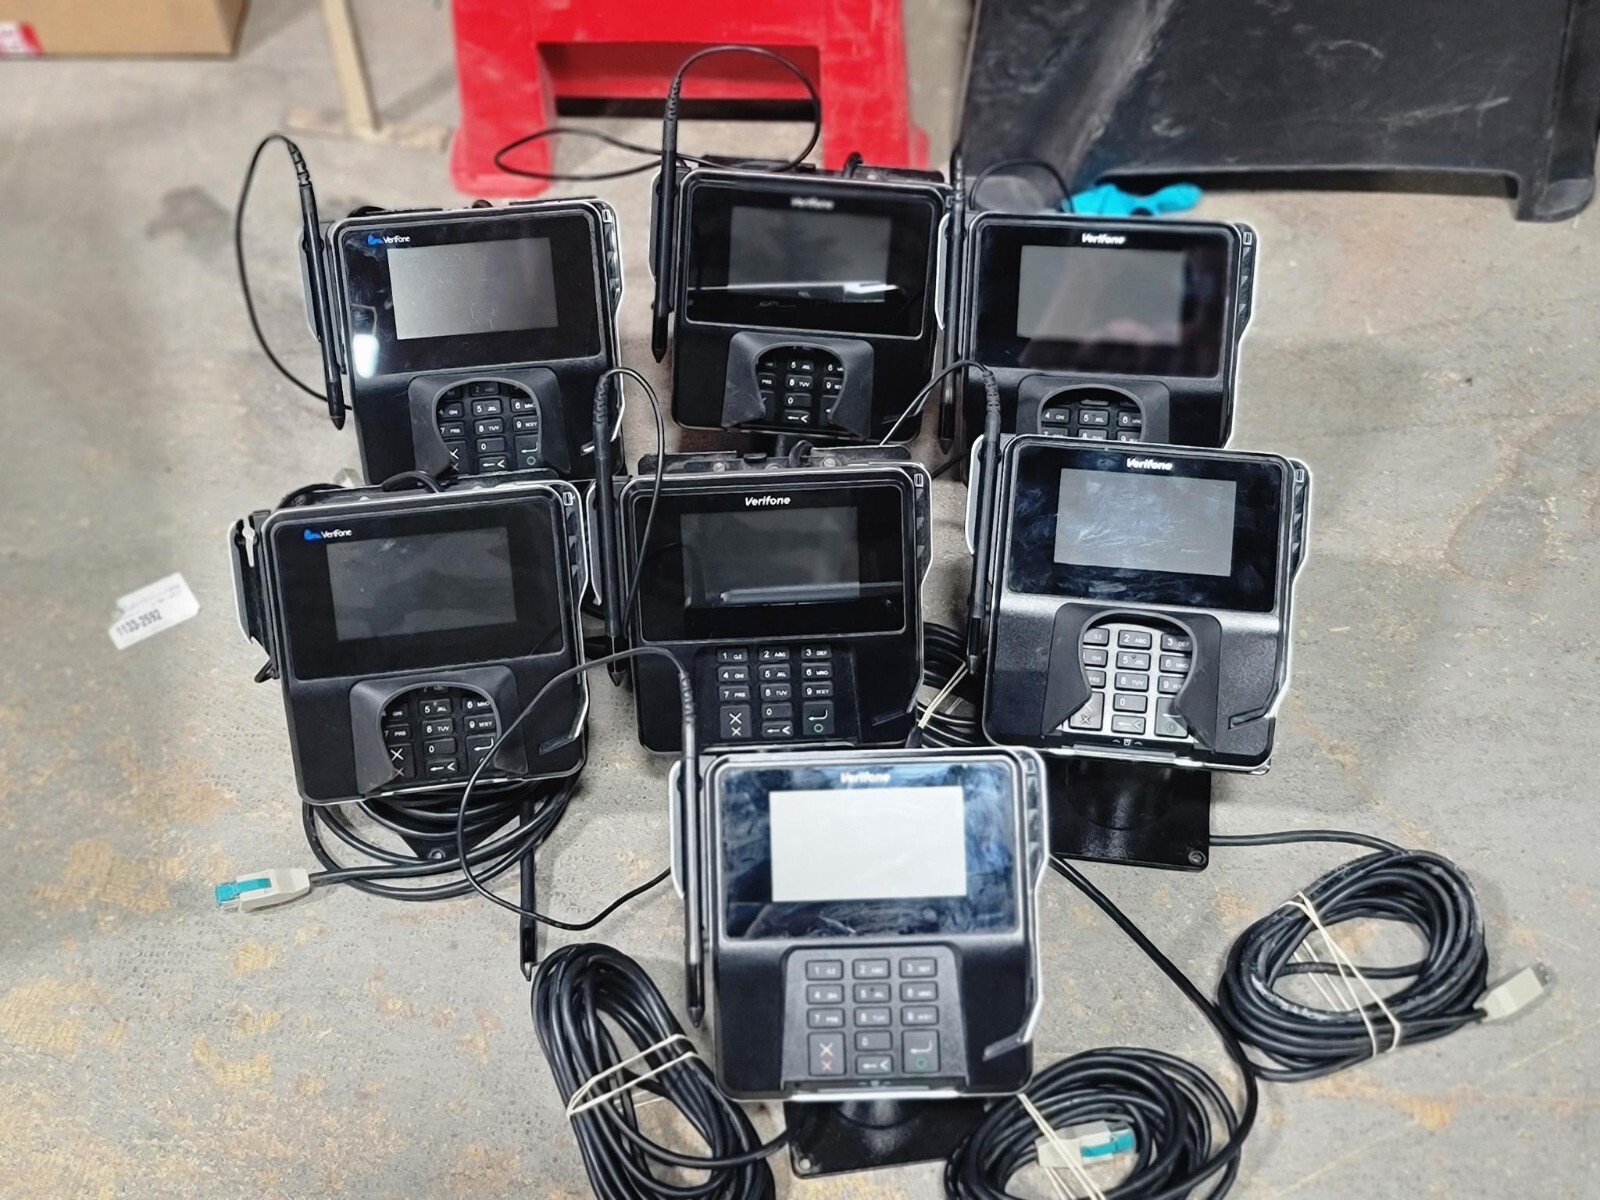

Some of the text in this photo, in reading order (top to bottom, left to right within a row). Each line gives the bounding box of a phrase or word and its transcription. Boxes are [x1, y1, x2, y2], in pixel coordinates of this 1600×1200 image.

[1082, 233, 1125, 245] Verifone
[1126, 458, 1173, 471] Verifone
[745, 495, 791, 507] Verifone
[1123, 634, 1130, 643] 2
[1167, 638, 1173, 646] 3
[763, 650, 770, 658] 2
[805, 648, 812, 656] 3
[1122, 656, 1129, 664] 5
[722, 671, 729, 679] 4
[764, 670, 771, 678] 5
[806, 668, 812, 676] 6
[723, 690, 730, 698] 7
[765, 688, 771, 697] 8
[806, 687, 813, 695] 9
[424, 705, 431, 714] 5
[426, 725, 432, 733] 8
